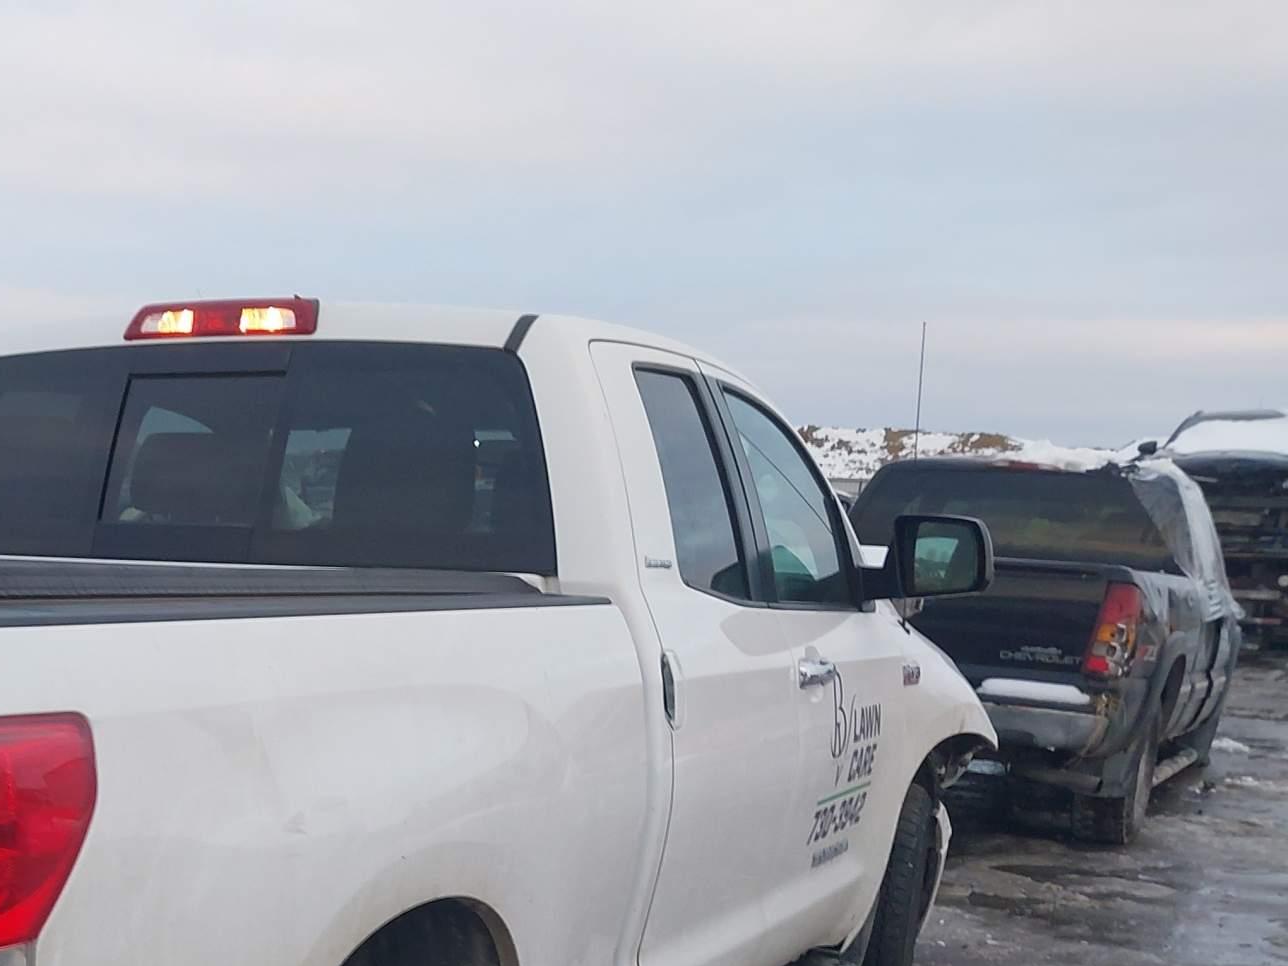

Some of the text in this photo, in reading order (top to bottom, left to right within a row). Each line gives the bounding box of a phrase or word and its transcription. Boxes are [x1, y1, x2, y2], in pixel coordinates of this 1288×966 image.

[853, 703, 882, 743] LAWN
[847, 743, 878, 782] CARE
[806, 791, 868, 847] 730-3942
